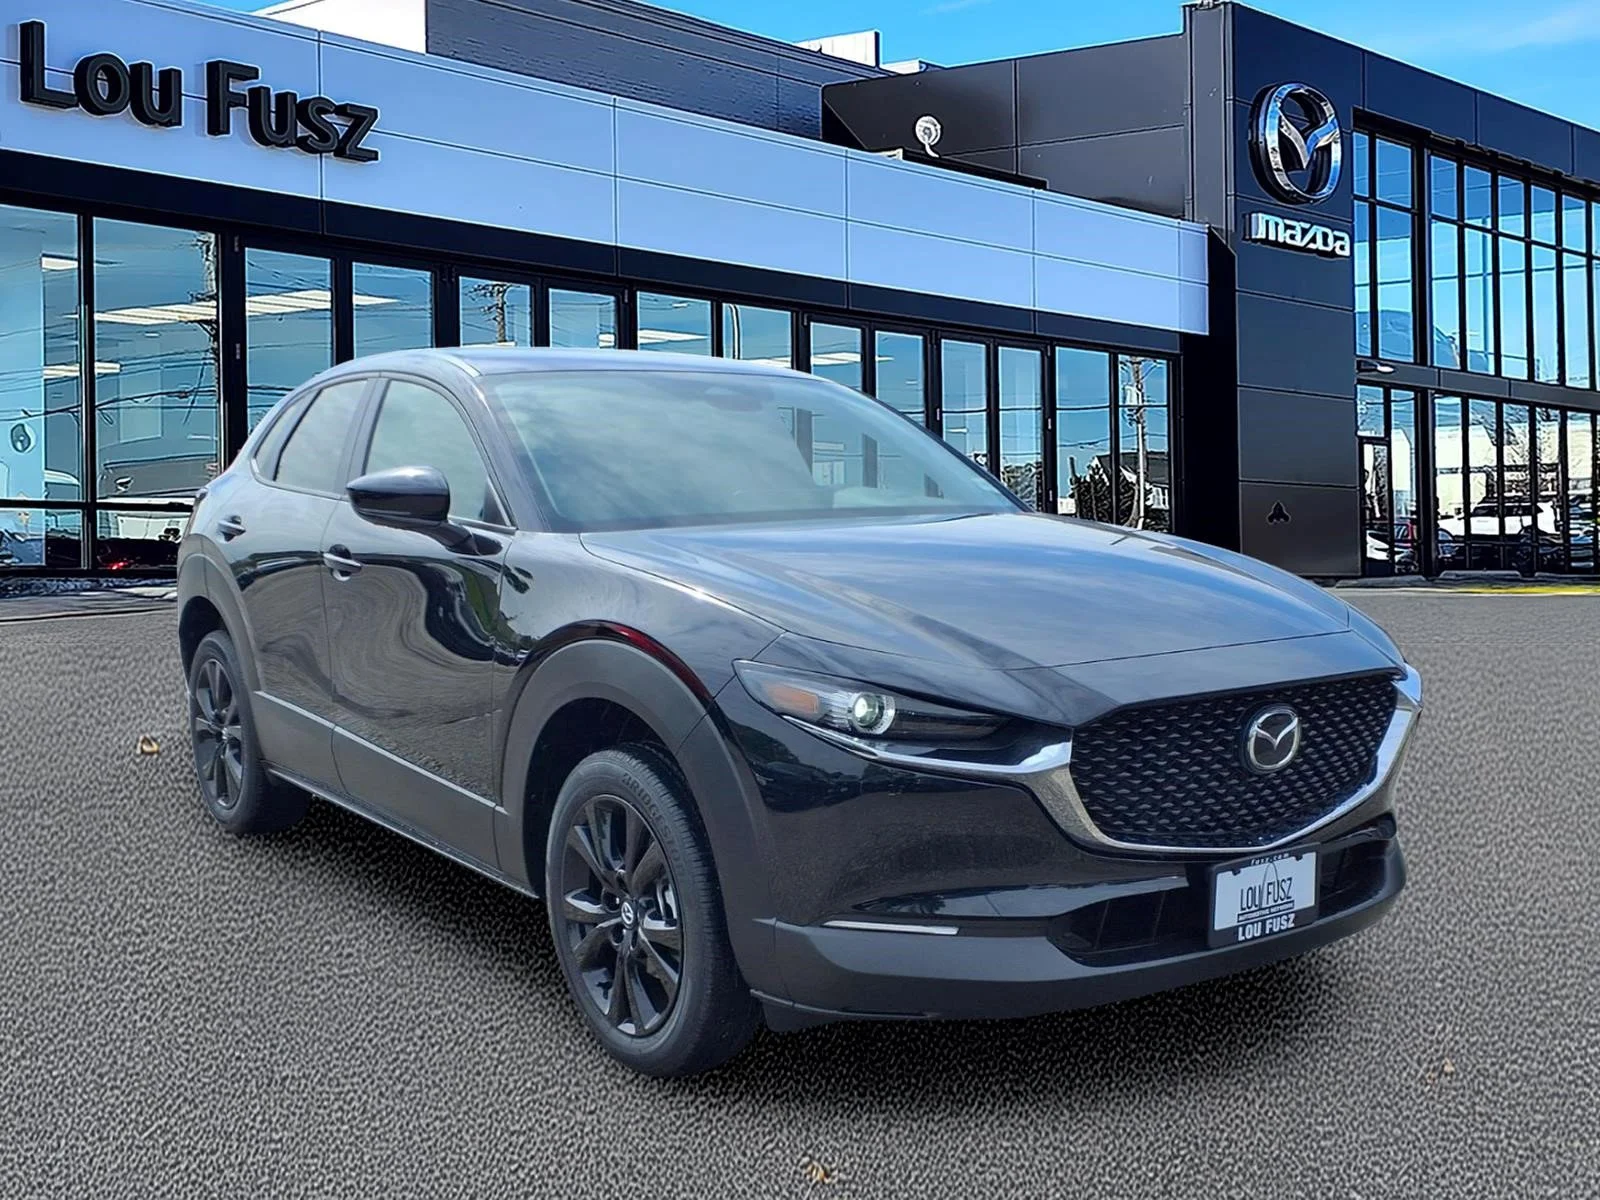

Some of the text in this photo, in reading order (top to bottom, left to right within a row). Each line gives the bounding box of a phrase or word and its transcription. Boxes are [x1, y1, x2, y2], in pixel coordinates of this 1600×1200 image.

[19, 20, 380, 163] Lou Fusz
[1240, 885, 1261, 911] LOU
[1266, 877, 1293, 904] FUSZ
[1238, 913, 1295, 941] LOU FUSZ
